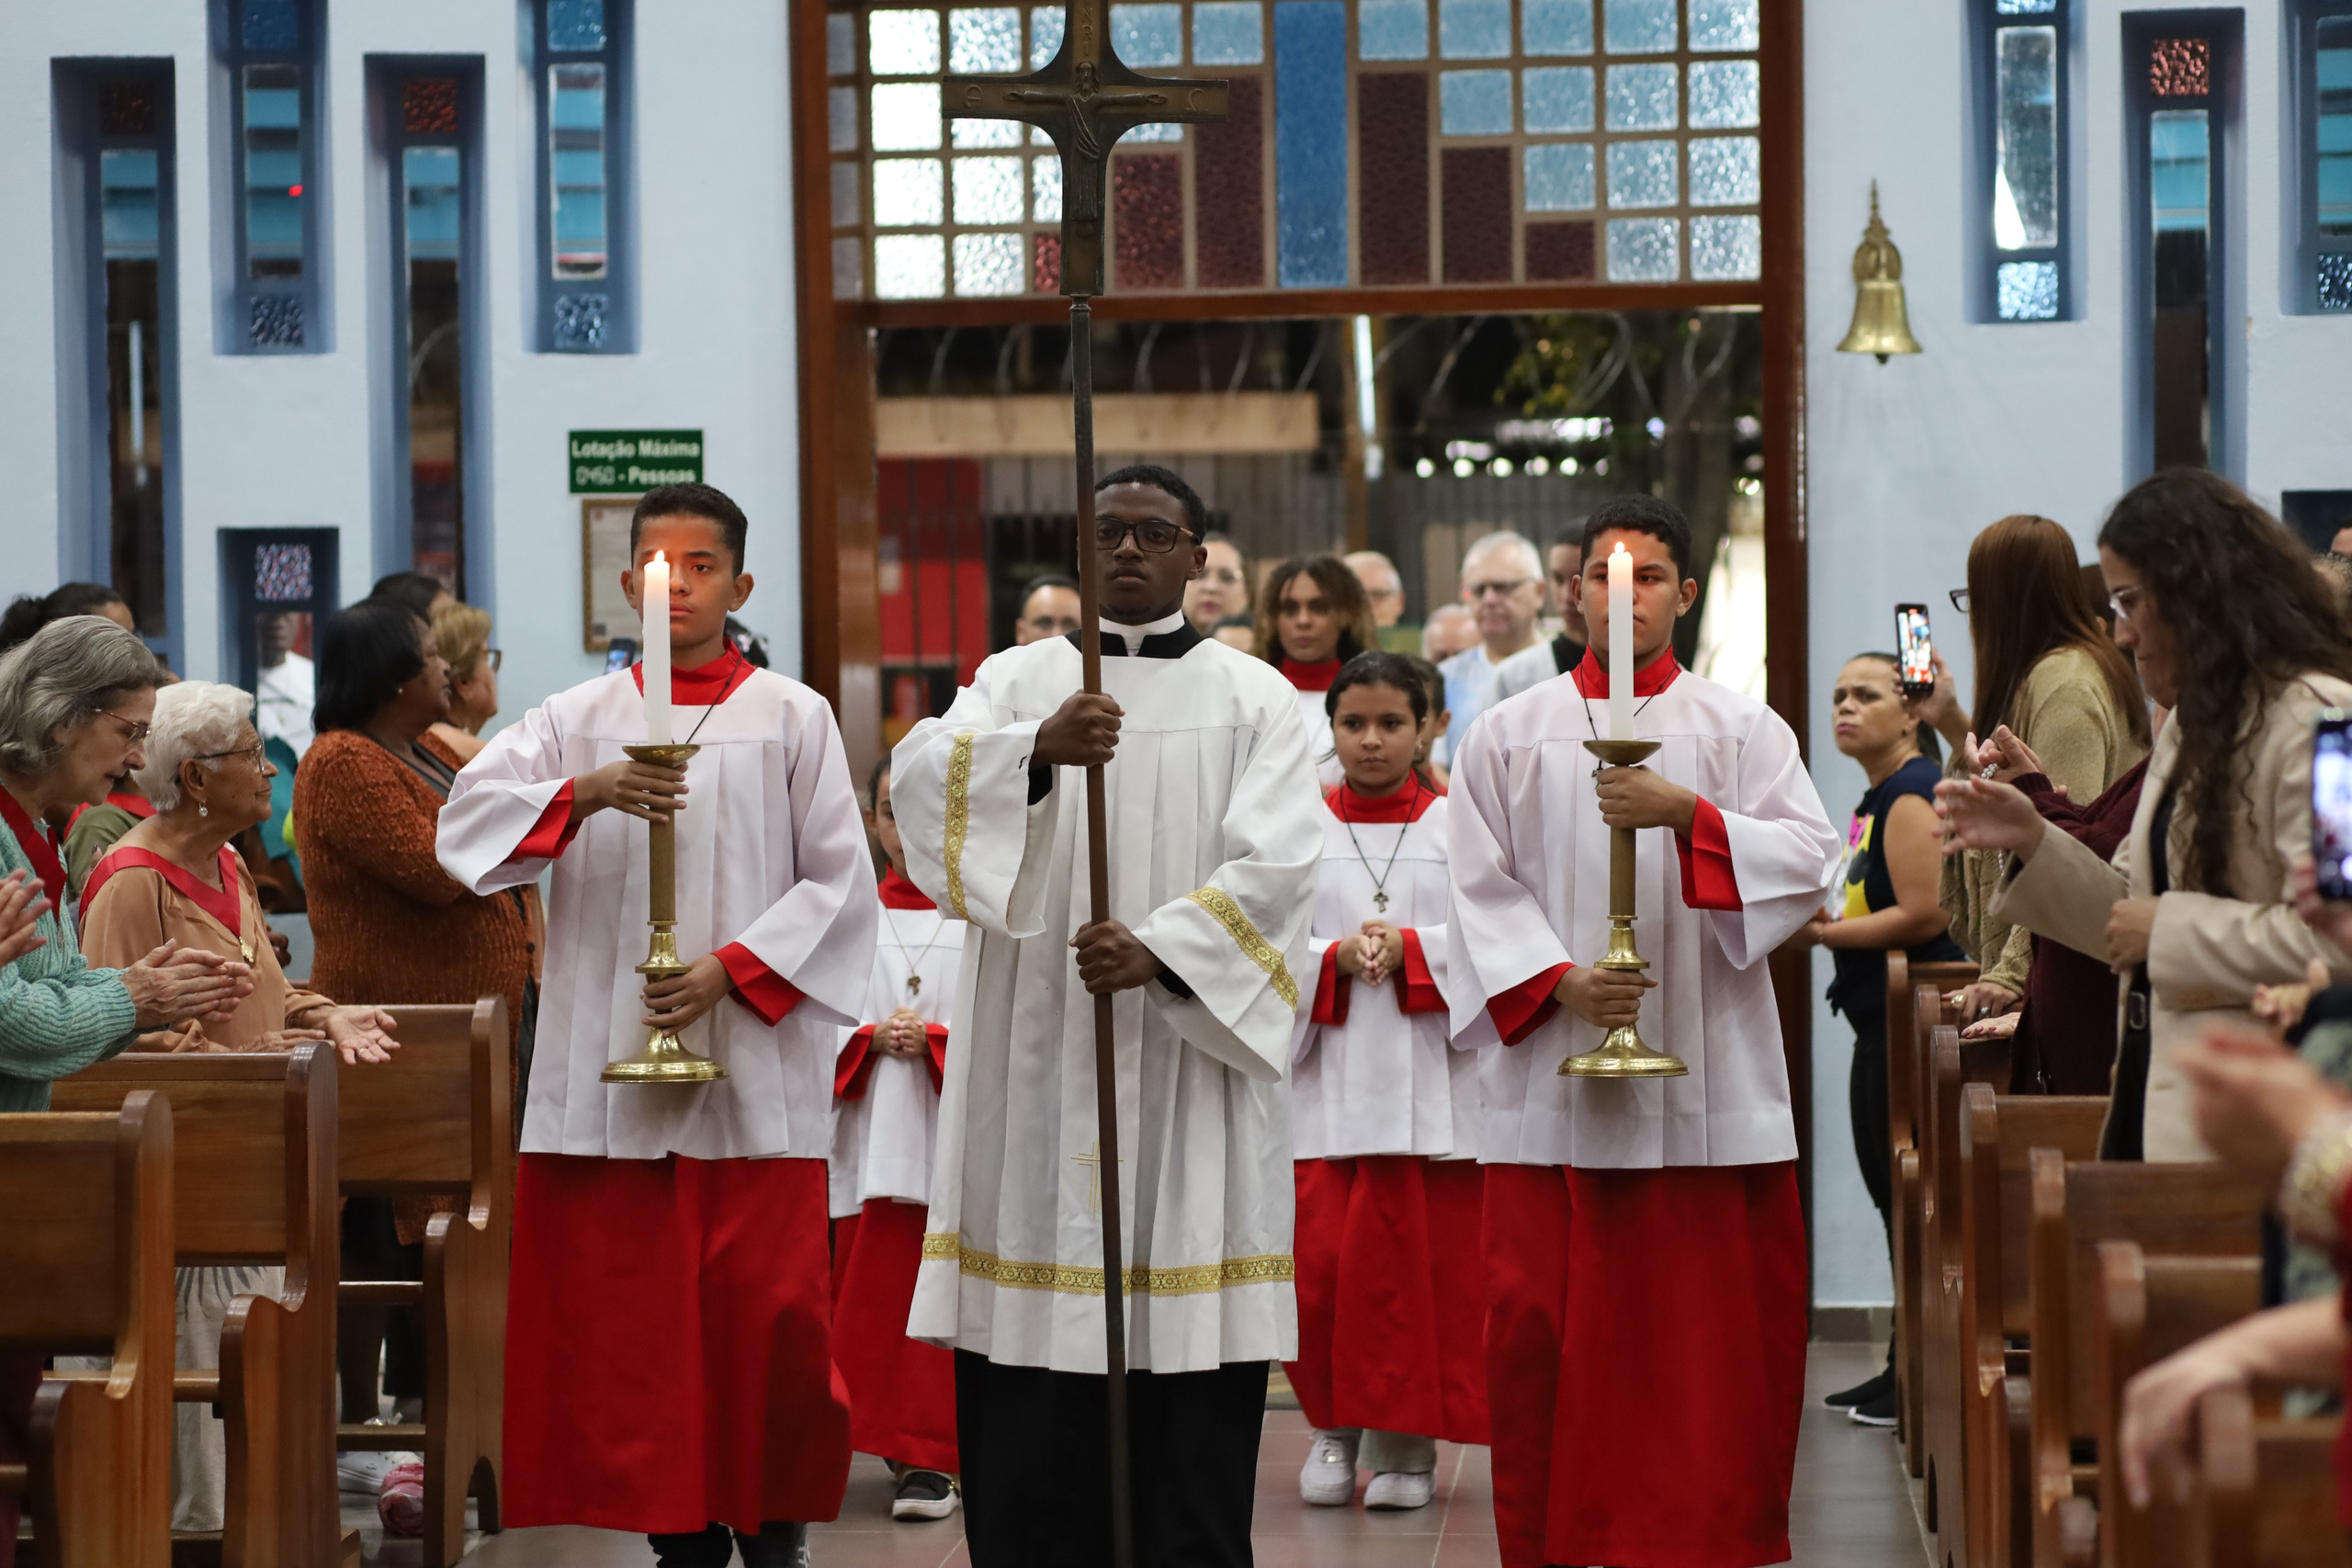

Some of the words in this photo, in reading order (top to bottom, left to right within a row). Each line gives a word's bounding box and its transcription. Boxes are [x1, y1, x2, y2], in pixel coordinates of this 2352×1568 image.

[1081, 2, 1093, 56] NRI
[571, 439, 636, 461] Lotação
[638, 439, 700, 457] Máxima
[628, 466, 696, 485] Pessoas
